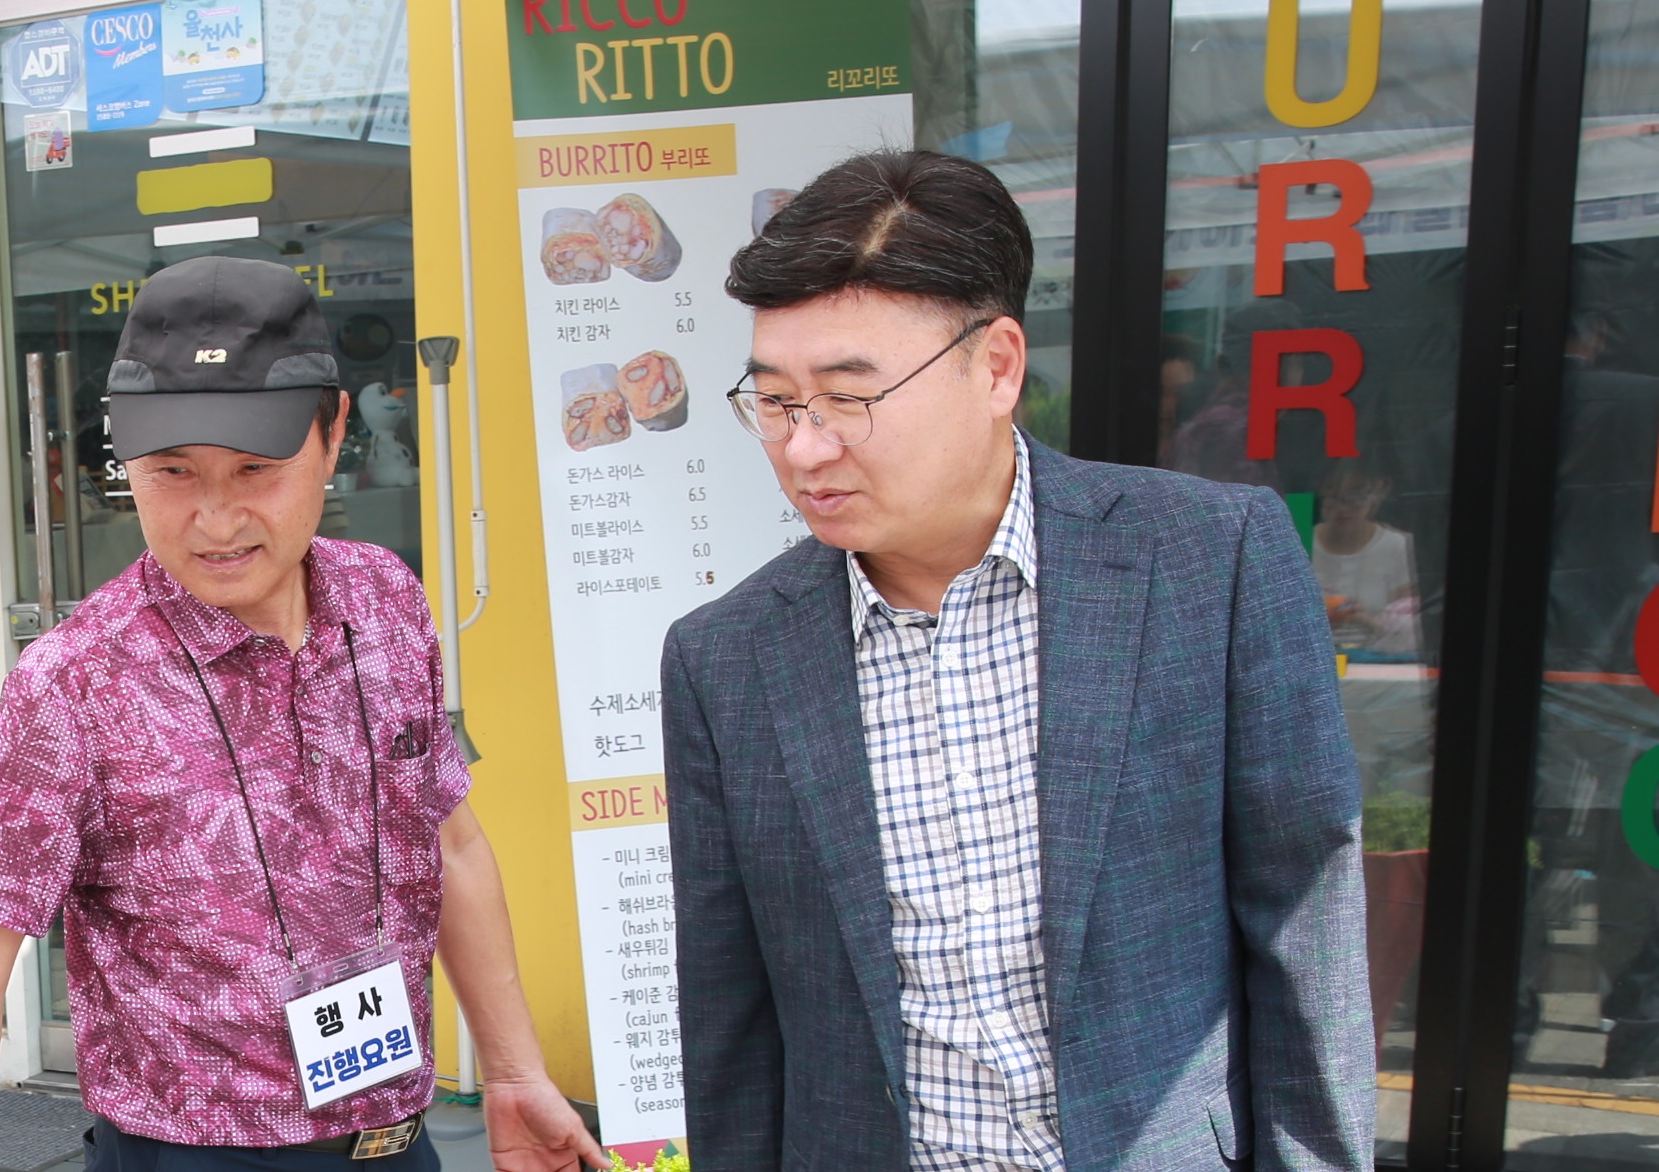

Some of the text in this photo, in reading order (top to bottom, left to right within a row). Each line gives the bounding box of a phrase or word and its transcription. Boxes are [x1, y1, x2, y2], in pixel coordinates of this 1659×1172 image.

[91, 12, 154, 46] CESCO
[183, 9, 243, 51] 율천사
[21, 44, 70, 81] ADT
[113, 41, 157, 70] Members
[575, 32, 734, 104] RITTO
[539, 141, 711, 178] BURRITO 부리또
[555, 297, 621, 315] 치킨 라이스
[675, 291, 692, 307] 5.5
[557, 324, 611, 342] 치킨 감자
[676, 318, 695, 333] 6.0
[194, 349, 228, 364] K2
[567, 464, 645, 484] 돈가스 라이스
[686, 459, 705, 474] 6.0
[569, 491, 631, 511] 돈가스감자
[688, 487, 706, 501] 6.5
[571, 519, 644, 539] 미트볼라이스
[691, 515, 708, 530] 5.5
[573, 547, 635, 566] 미트볼감자
[692, 543, 711, 558] 6.0
[577, 576, 662, 596] 라이스포테이토
[695, 571, 715, 586] 5.5
[594, 734, 645, 758] 핫도그
[581, 787, 644, 821] SIDE
[615, 848, 640, 866] 미니
[618, 869, 651, 889] (mini
[622, 918, 659, 937] (hash
[618, 937, 669, 958] 새우튀김
[621, 962, 670, 981] (shrimp
[622, 987, 662, 1006] 케이준
[626, 1010, 668, 1028] (cajun
[625, 1030, 652, 1049] 웨지
[306, 1025, 414, 1093] 진행요원
[630, 1073, 657, 1092] 양념
